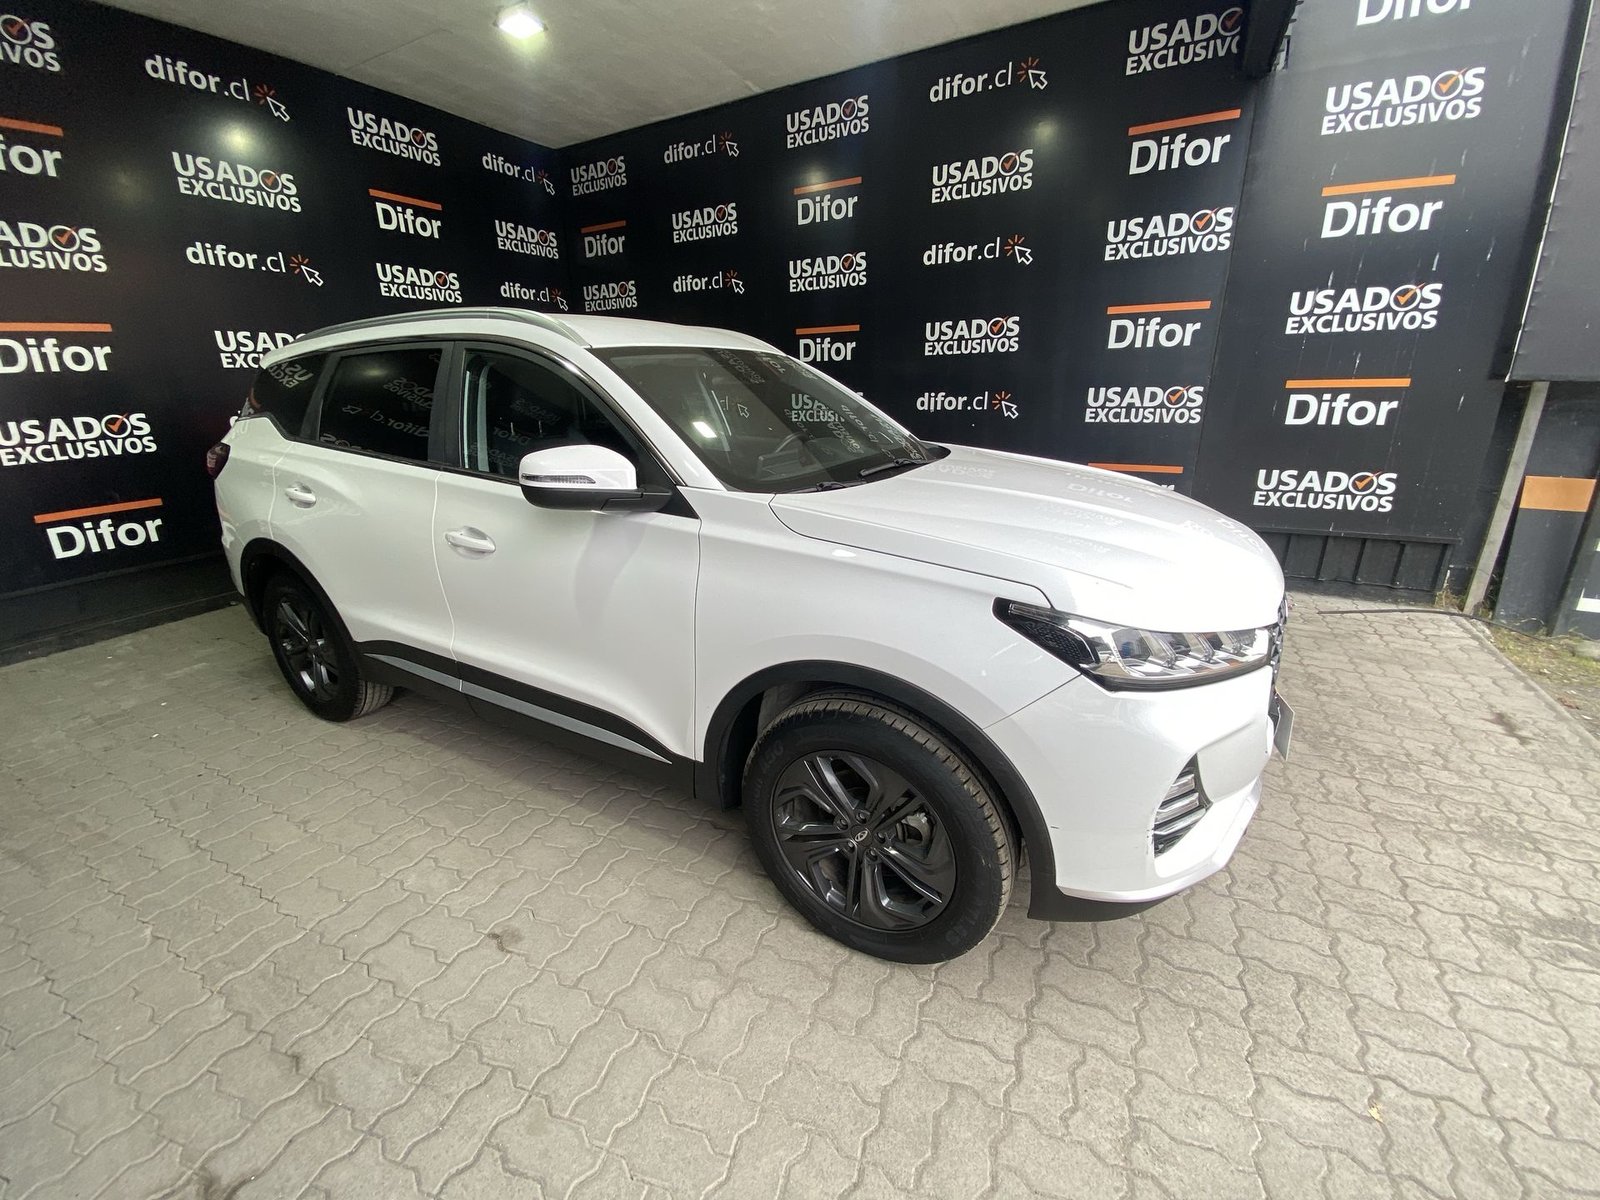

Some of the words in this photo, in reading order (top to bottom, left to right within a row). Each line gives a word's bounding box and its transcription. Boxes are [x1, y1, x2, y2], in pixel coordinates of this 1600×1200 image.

[1128, 7, 1243, 54] USADO
[145, 55, 250, 101] difor.cl
[929, 61, 1013, 102] difor.cl
[1325, 66, 1487, 113] USADOS
[786, 95, 869, 133] USADOS
[1320, 97, 1482, 136] EXCLUSIVOS
[347, 107, 439, 152] USADOS
[787, 117, 869, 149] EXCLUSIVOS
[351, 129, 441, 167] EXCLUSIVOS
[664, 134, 716, 164] difor.cl
[1129, 133, 1231, 175] Difor
[172, 152, 297, 195] USADOS
[482, 152, 536, 183] difor.cl
[570, 155, 626, 184] USADOS
[932, 148, 1034, 187] USADOS
[177, 176, 301, 213] EXCLUSIVOS
[572, 173, 628, 197] EXCLUSIVOS
[931, 172, 1033, 203] EXCLUSIVOS
[375, 202, 442, 239] Difor
[671, 202, 737, 230] USADOS
[797, 194, 858, 225] Difor
[1321, 196, 1443, 238] Difor
[495, 220, 557, 248] USADOS
[673, 221, 738, 243] EXCLUSIVOS
[1107, 206, 1235, 243] USADOS
[186, 241, 286, 273] difor.cl
[497, 237, 559, 260] EXCLUSIVOS
[584, 234, 625, 258] Difor
[922, 237, 1001, 266] difor.cl
[1104, 233, 1231, 261] EXCLUSIVOS
[376, 262, 460, 290] USADOS
[789, 251, 867, 279] USADOS
[380, 282, 462, 303] EXCLUSIVOS
[500, 282, 550, 303] difor.cl
[583, 281, 637, 301] USADOS
[672, 271, 723, 293] difor.cl
[789, 271, 867, 293] EXCLUSIVOS
[585, 296, 638, 313] EXCLUSIVOS
[1290, 284, 1442, 316] USADOS
[925, 316, 1020, 341] USADOS
[1107, 317, 1201, 349] Difor
[1285, 309, 1438, 334] EXCLUSIVOS
[214, 330, 306, 352] USAD
[799, 337, 857, 363] Difor
[923, 337, 1019, 356] EXCLUSIVOS
[0, 338, 112, 374] Difor
[220, 353, 267, 369] EXC
[916, 391, 988, 411] difor.cl
[1087, 386, 1204, 408] USADOS
[1285, 393, 1398, 425] Difor
[0, 412, 151, 447] USADOS
[1084, 408, 1202, 424] EXCLUSIVOS
[0, 436, 158, 467] EXCLUSIVOS
[1257, 469, 1398, 494] USADOS
[1253, 491, 1393, 512] EXCLUSIVOS
[46, 518, 162, 559] Difor
